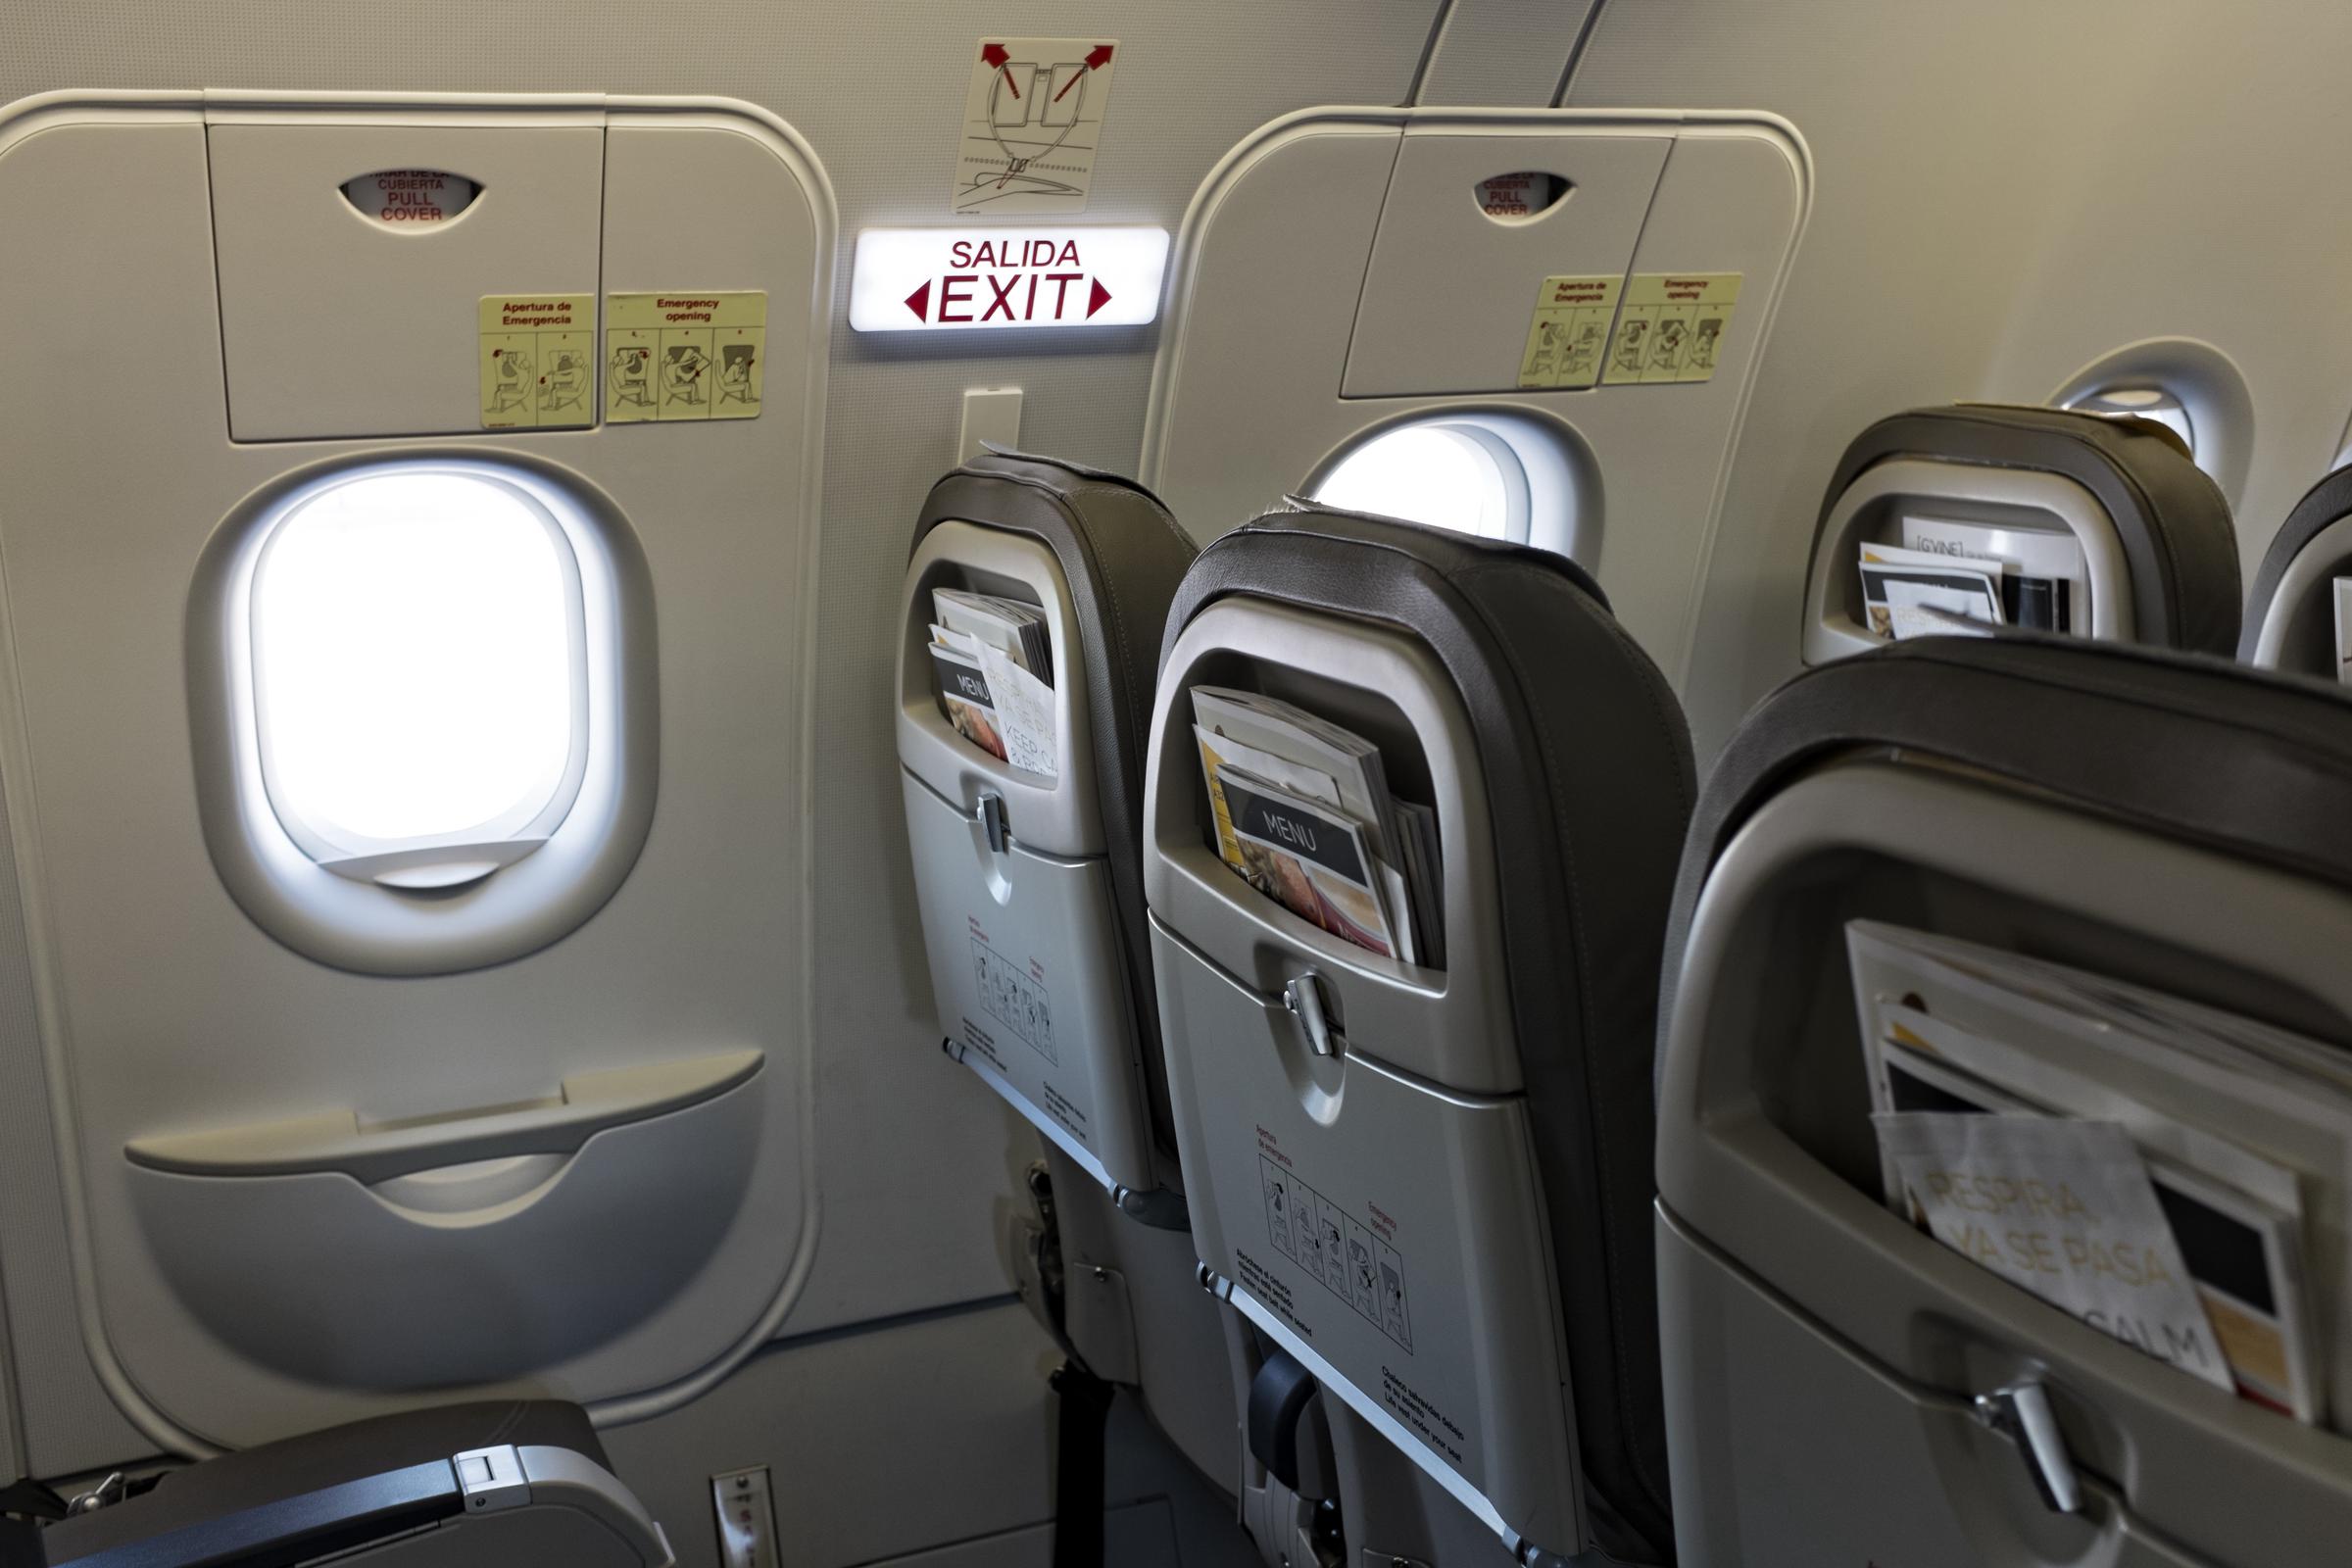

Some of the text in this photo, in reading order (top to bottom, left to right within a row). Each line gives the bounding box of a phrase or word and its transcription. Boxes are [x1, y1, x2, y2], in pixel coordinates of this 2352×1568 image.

[378, 178, 444, 190] CUBIERTA
[388, 192, 433, 206] PULL
[1491, 191, 1522, 203] PULL
[380, 207, 442, 220] COVER
[1485, 204, 1528, 216] COVER
[950, 239, 1081, 268] SALIDA
[938, 273, 1084, 322] EXIT
[503, 302, 571, 314] Apertura de
[657, 299, 720, 310] Emergency
[503, 315, 571, 326] Emergencia
[665, 312, 711, 322] opening
[956, 673, 990, 701] MENU
[1262, 809, 1317, 852] MENU
[2006, 1229, 2061, 1274] SE
[2061, 1235, 2178, 1289] PASA
